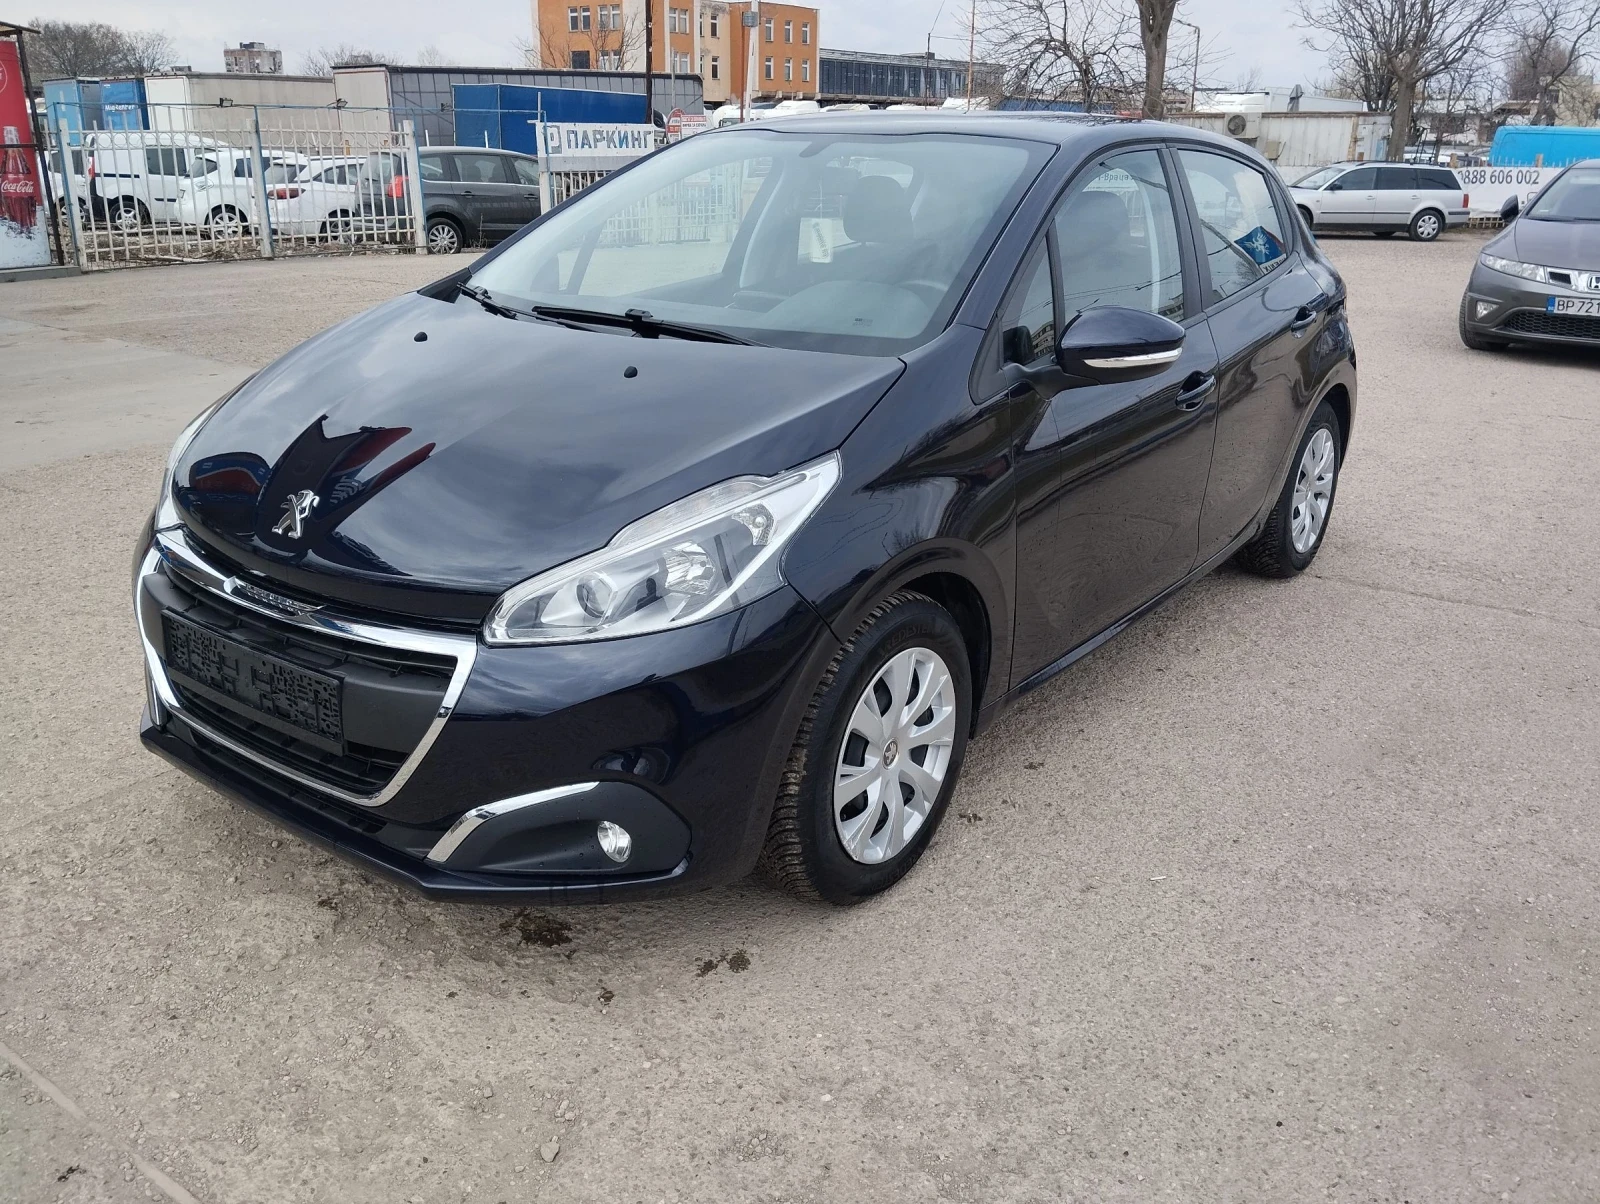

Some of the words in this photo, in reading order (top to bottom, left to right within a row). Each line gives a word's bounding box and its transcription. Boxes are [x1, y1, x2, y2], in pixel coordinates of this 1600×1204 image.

[567, 129, 652, 149] ПАРКИНГ
[1490, 169, 1513, 184] 606
[1516, 170, 1540, 185] 002
[1557, 299, 1575, 311] BP
